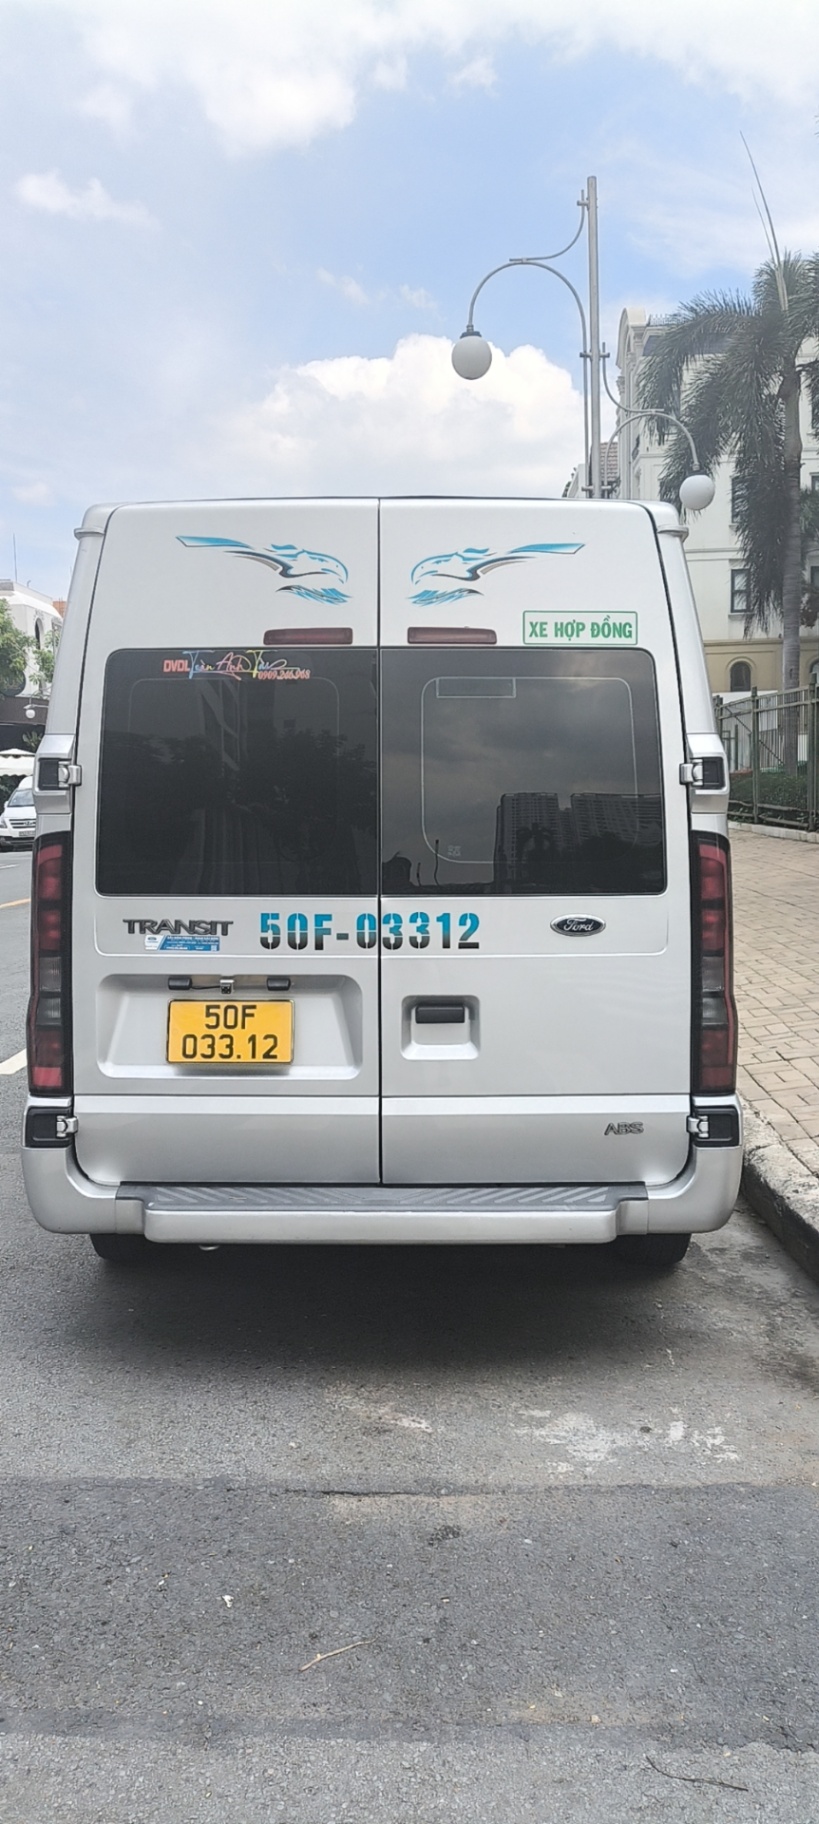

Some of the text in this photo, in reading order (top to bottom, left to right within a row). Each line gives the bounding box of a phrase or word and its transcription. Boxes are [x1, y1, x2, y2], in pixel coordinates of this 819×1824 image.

[529, 614, 633, 641] XE HỢP ĐỒNG
[163, 659, 190, 673] DVDL
[216, 651, 251, 680] Anh
[122, 918, 234, 936] TRANSIT
[260, 912, 480, 950] 50F-03312
[563, 917, 595, 932] Ford
[205, 1004, 257, 1030] 50F
[182, 1033, 278, 1059] 033.12
[604, 1121, 645, 1136] ABS
